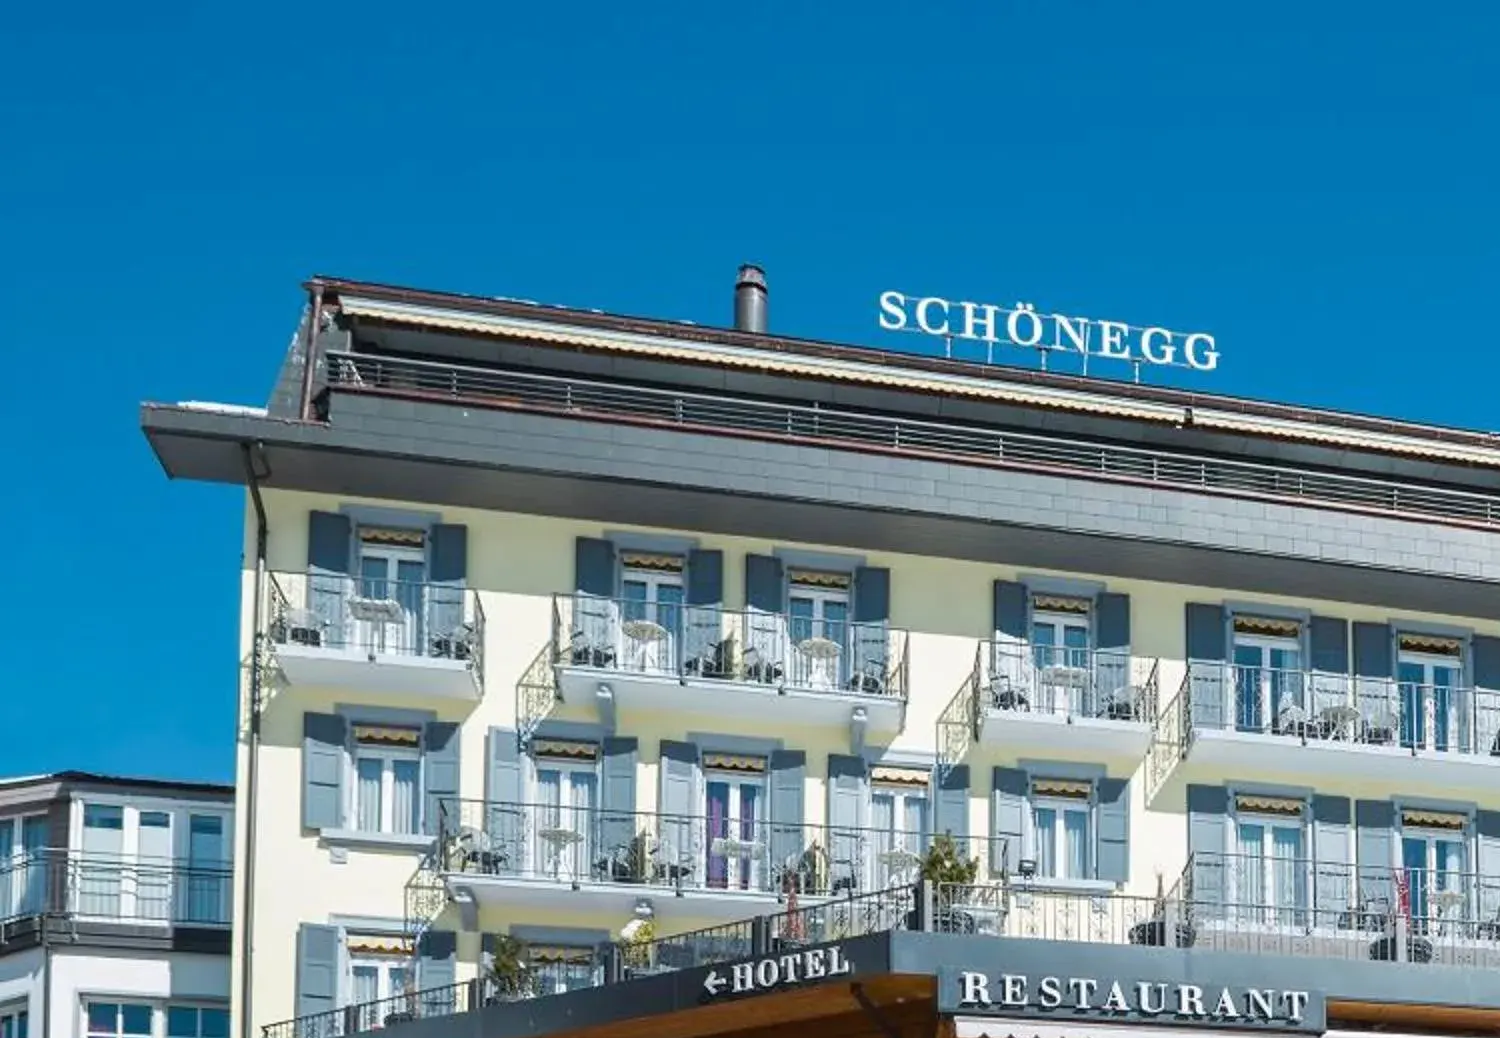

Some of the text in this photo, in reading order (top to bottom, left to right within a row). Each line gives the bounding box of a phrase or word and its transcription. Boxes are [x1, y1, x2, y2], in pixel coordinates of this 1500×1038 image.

[879, 291, 1221, 370] SCHÖNEGG
[731, 946, 850, 993] HOTEL
[961, 971, 1309, 1021] RESTAURANT
